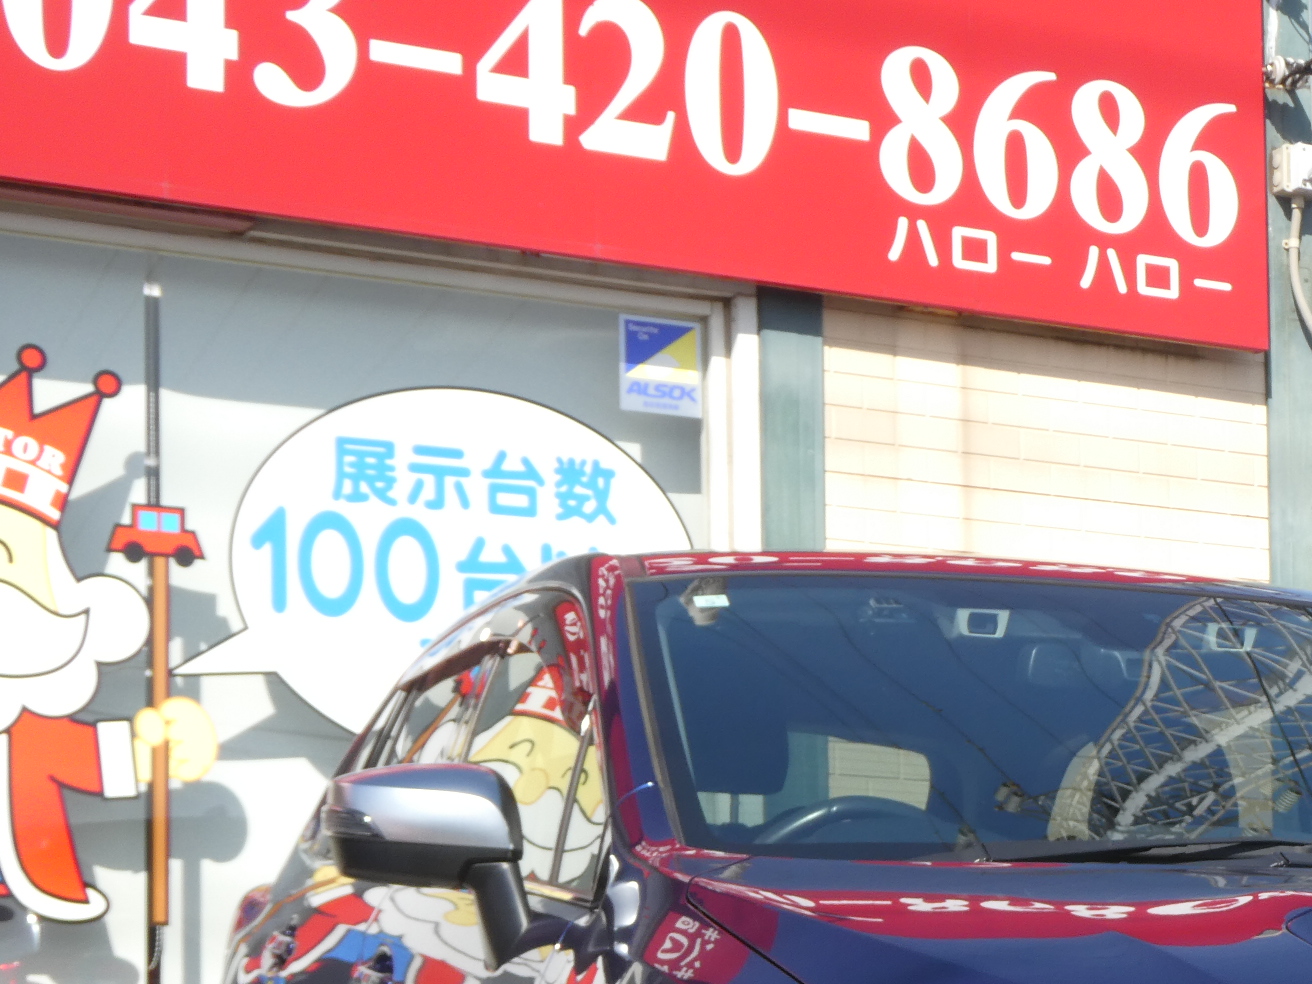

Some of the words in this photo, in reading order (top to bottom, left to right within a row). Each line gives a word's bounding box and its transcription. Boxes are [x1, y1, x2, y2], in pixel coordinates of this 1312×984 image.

[887, 215, 1052, 274] ハロー
[1079, 245, 1233, 300] ハロー
[626, 380, 698, 403] ALSOK
[331, 435, 618, 526] 展示台数
[250, 506, 598, 623] 100台
